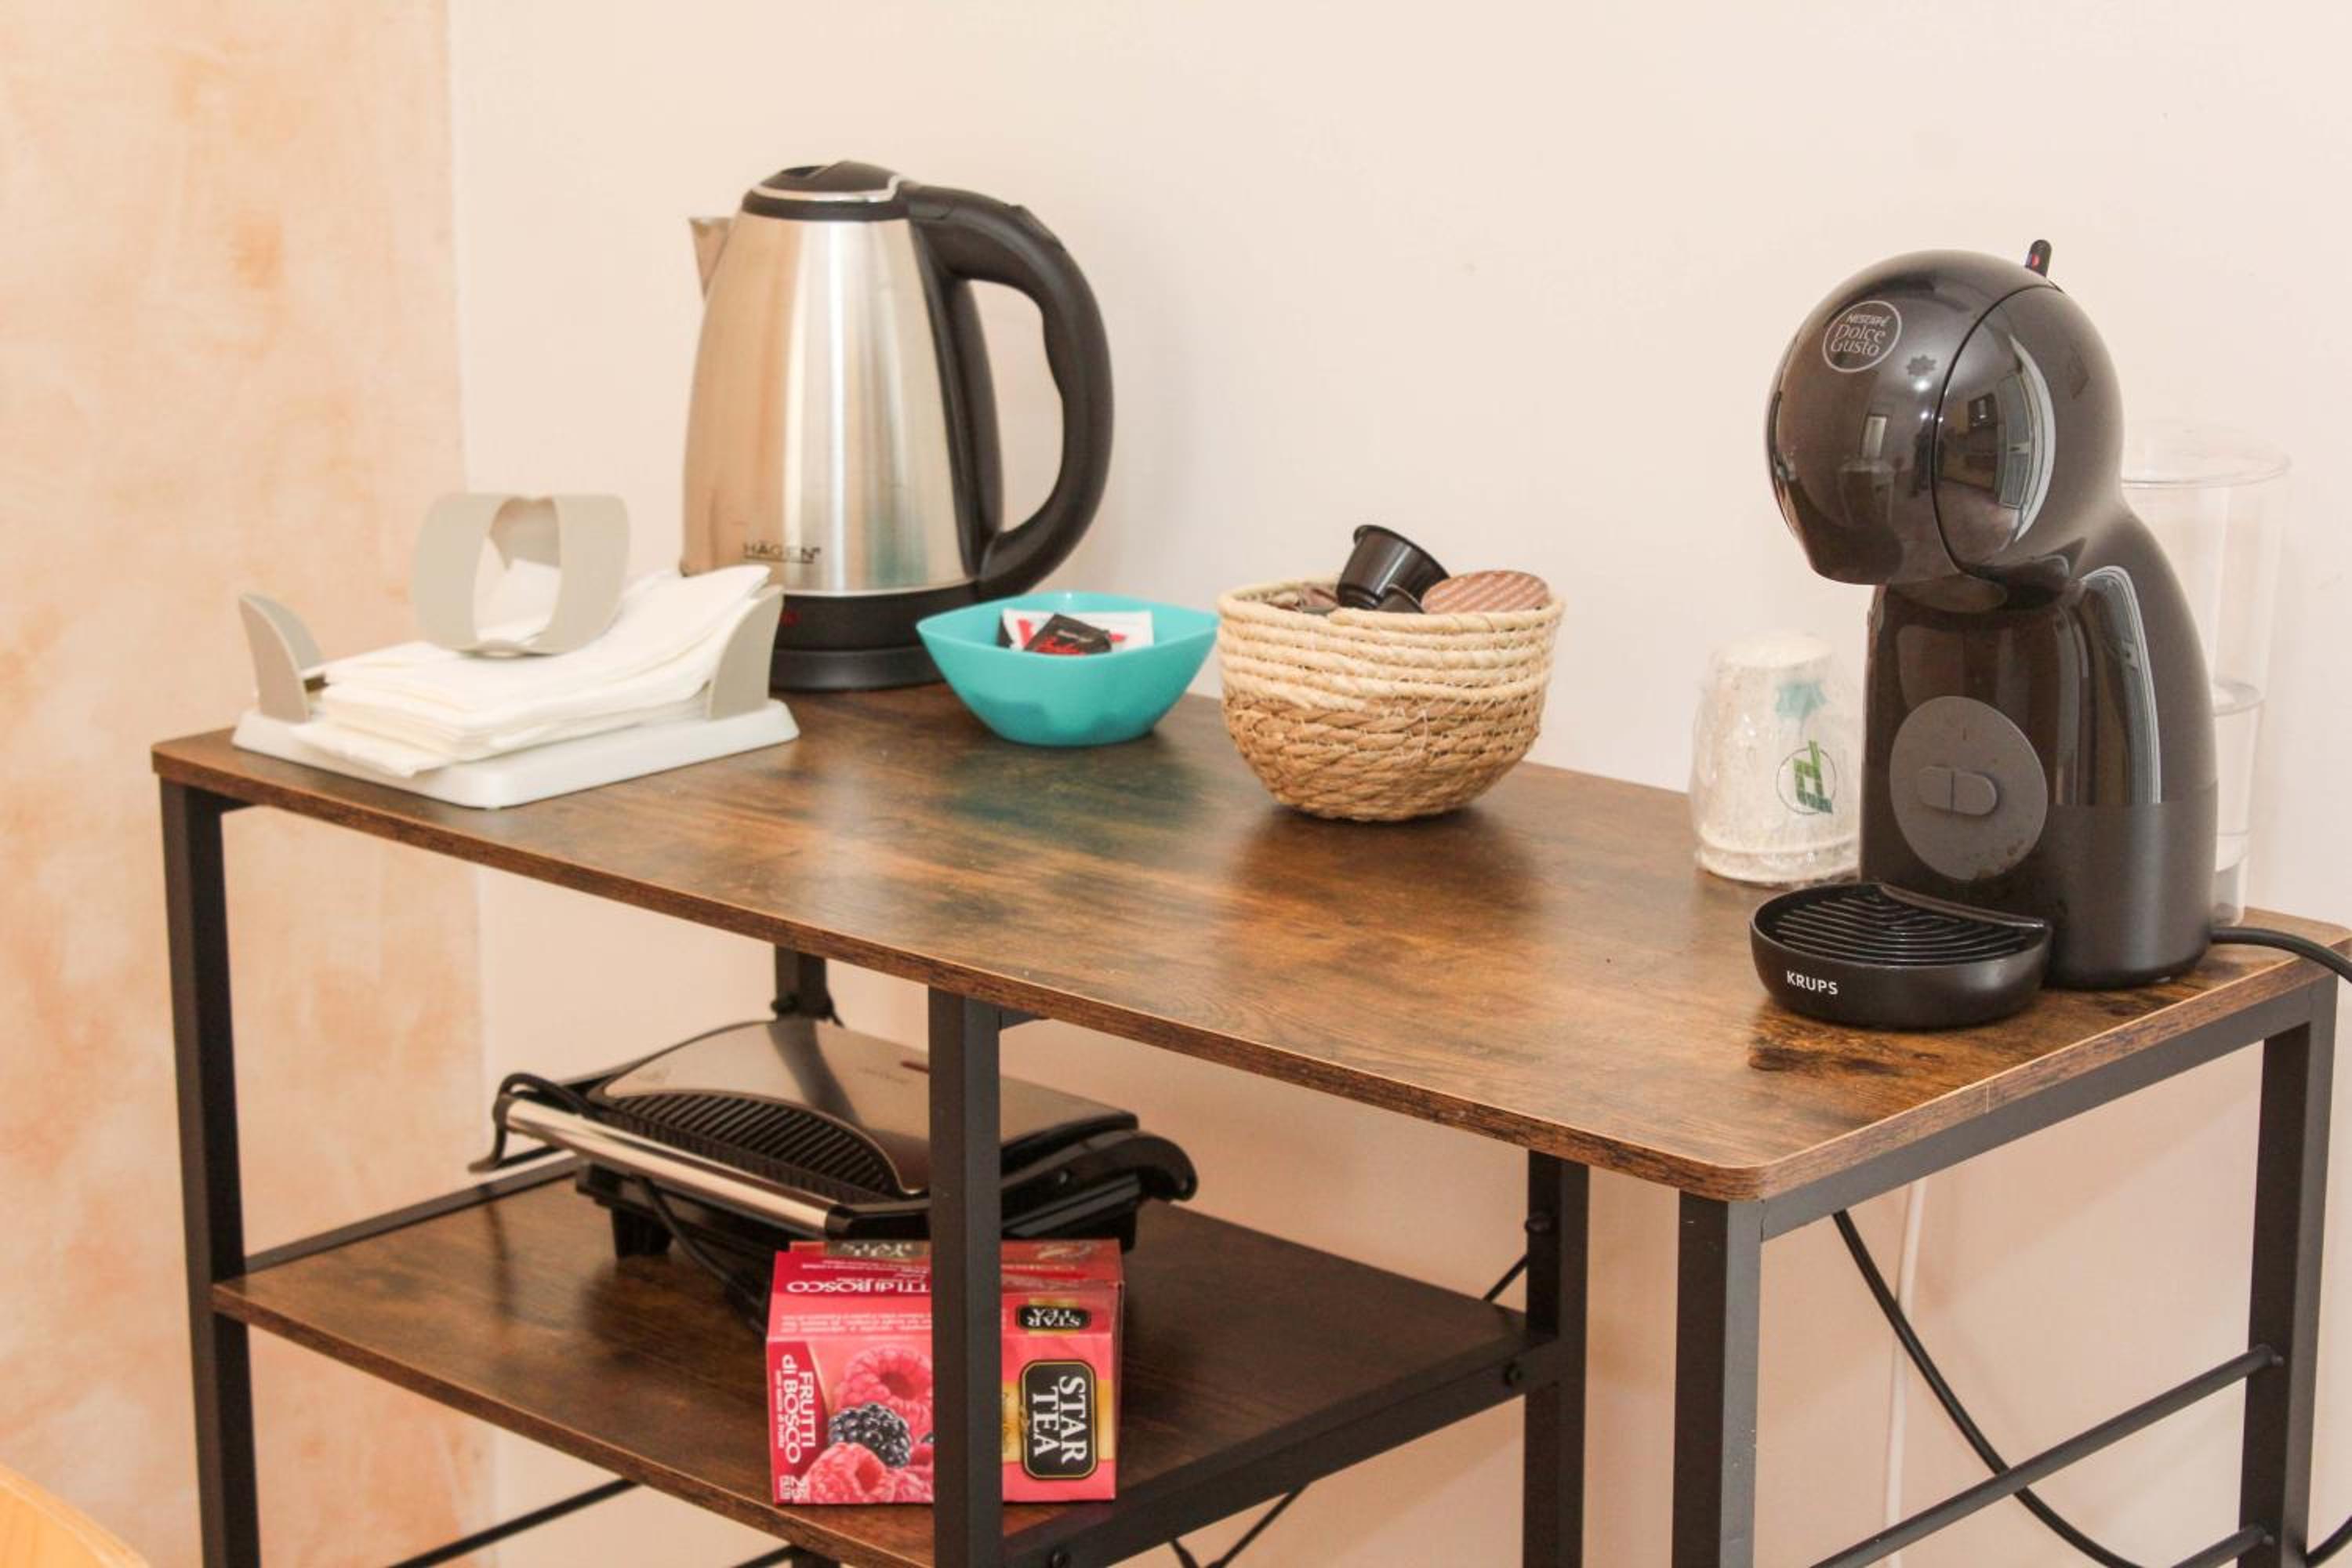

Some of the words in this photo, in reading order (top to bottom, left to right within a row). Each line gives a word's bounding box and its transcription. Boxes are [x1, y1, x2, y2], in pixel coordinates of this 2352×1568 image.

[1835, 323, 1886, 343] Dolce
[1831, 339, 1880, 357] Gusto
[1787, 970, 1838, 995] KRUPS
[786, 1279, 871, 1293] BOSCO
[1027, 1316, 1080, 1327] STAR
[782, 1354, 798, 1374] di
[798, 1370, 817, 1448] FRUTTI
[1058, 1375, 1087, 1465] STAR
[784, 1378, 802, 1465] BOSCO
[1032, 1385, 1060, 1457] TEA
